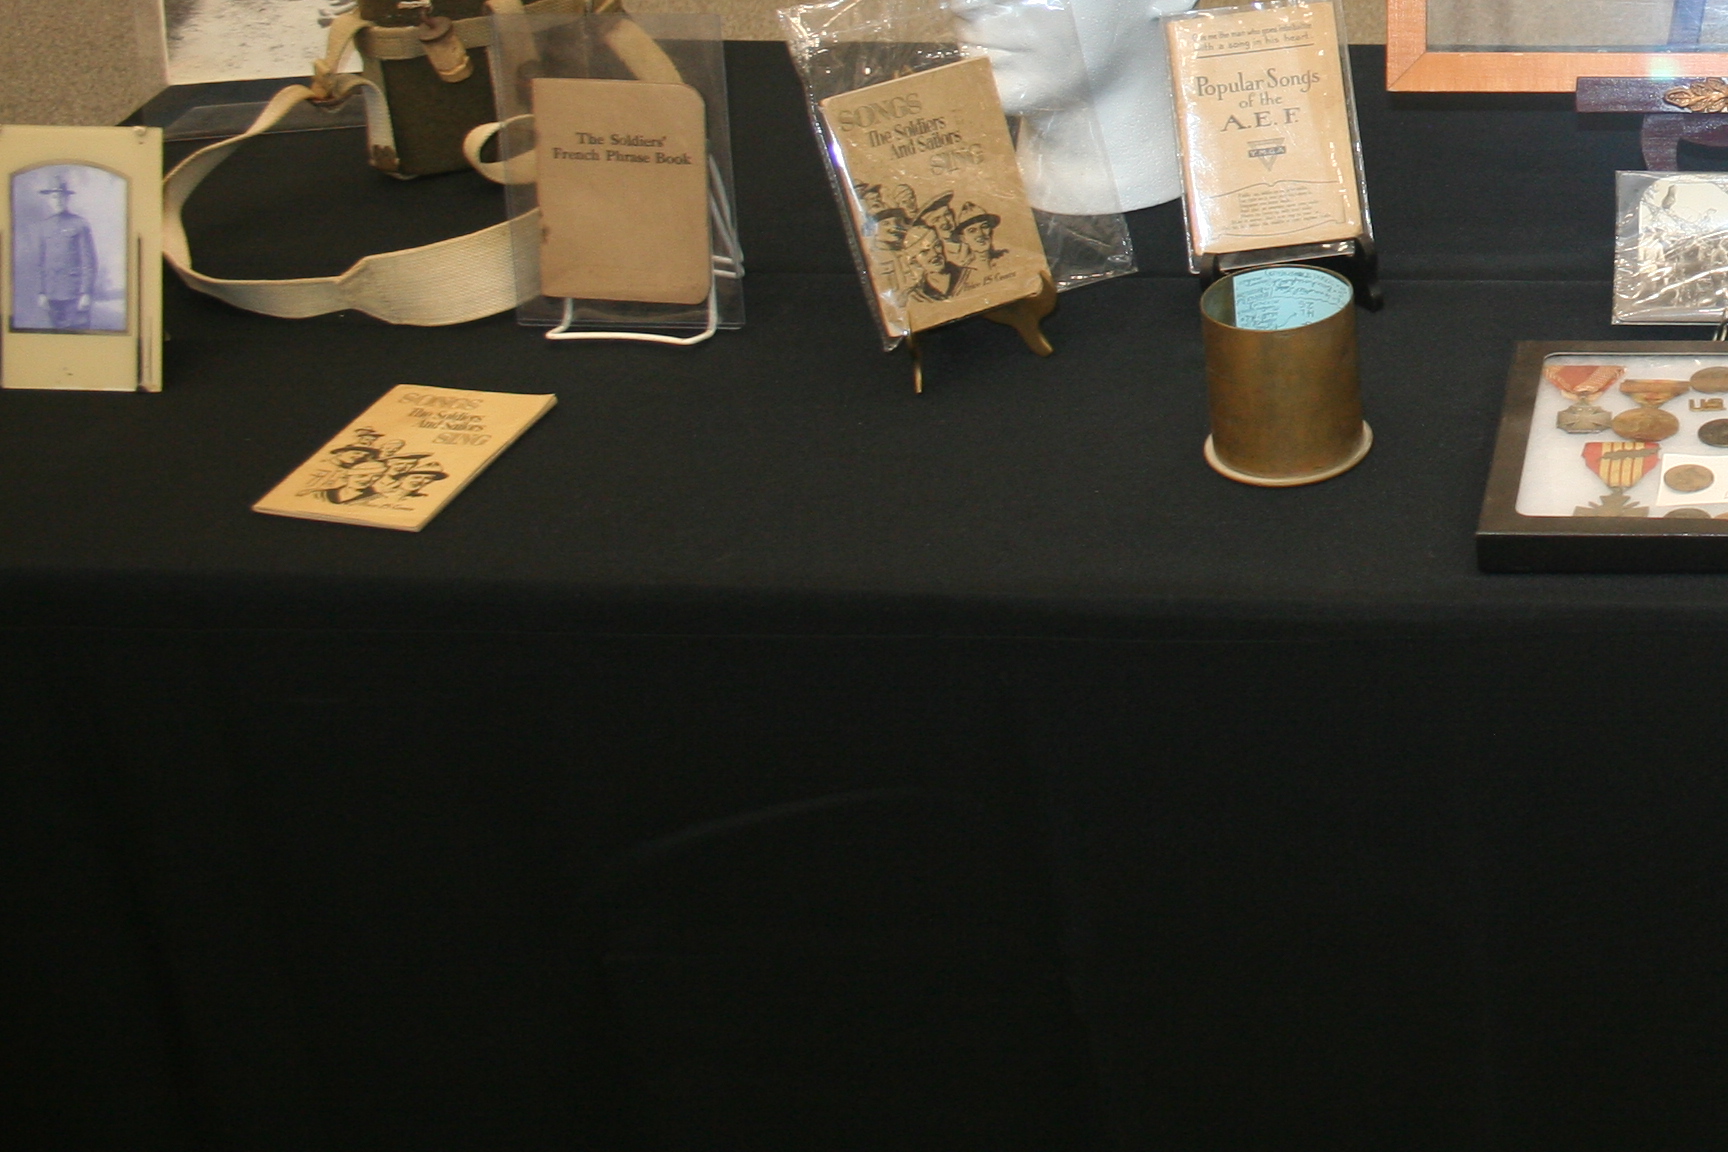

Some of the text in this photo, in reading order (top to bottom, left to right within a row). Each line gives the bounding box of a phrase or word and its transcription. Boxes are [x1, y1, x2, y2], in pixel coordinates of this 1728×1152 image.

[1196, 68, 1320, 100] Popular Songs
[838, 93, 922, 132] SONGS
[1239, 91, 1282, 108] of the
[575, 132, 604, 145] The
[868, 116, 947, 148] The Soldiers
[890, 130, 962, 159] And Sailors
[552, 147, 692, 165] French Phrase Book
